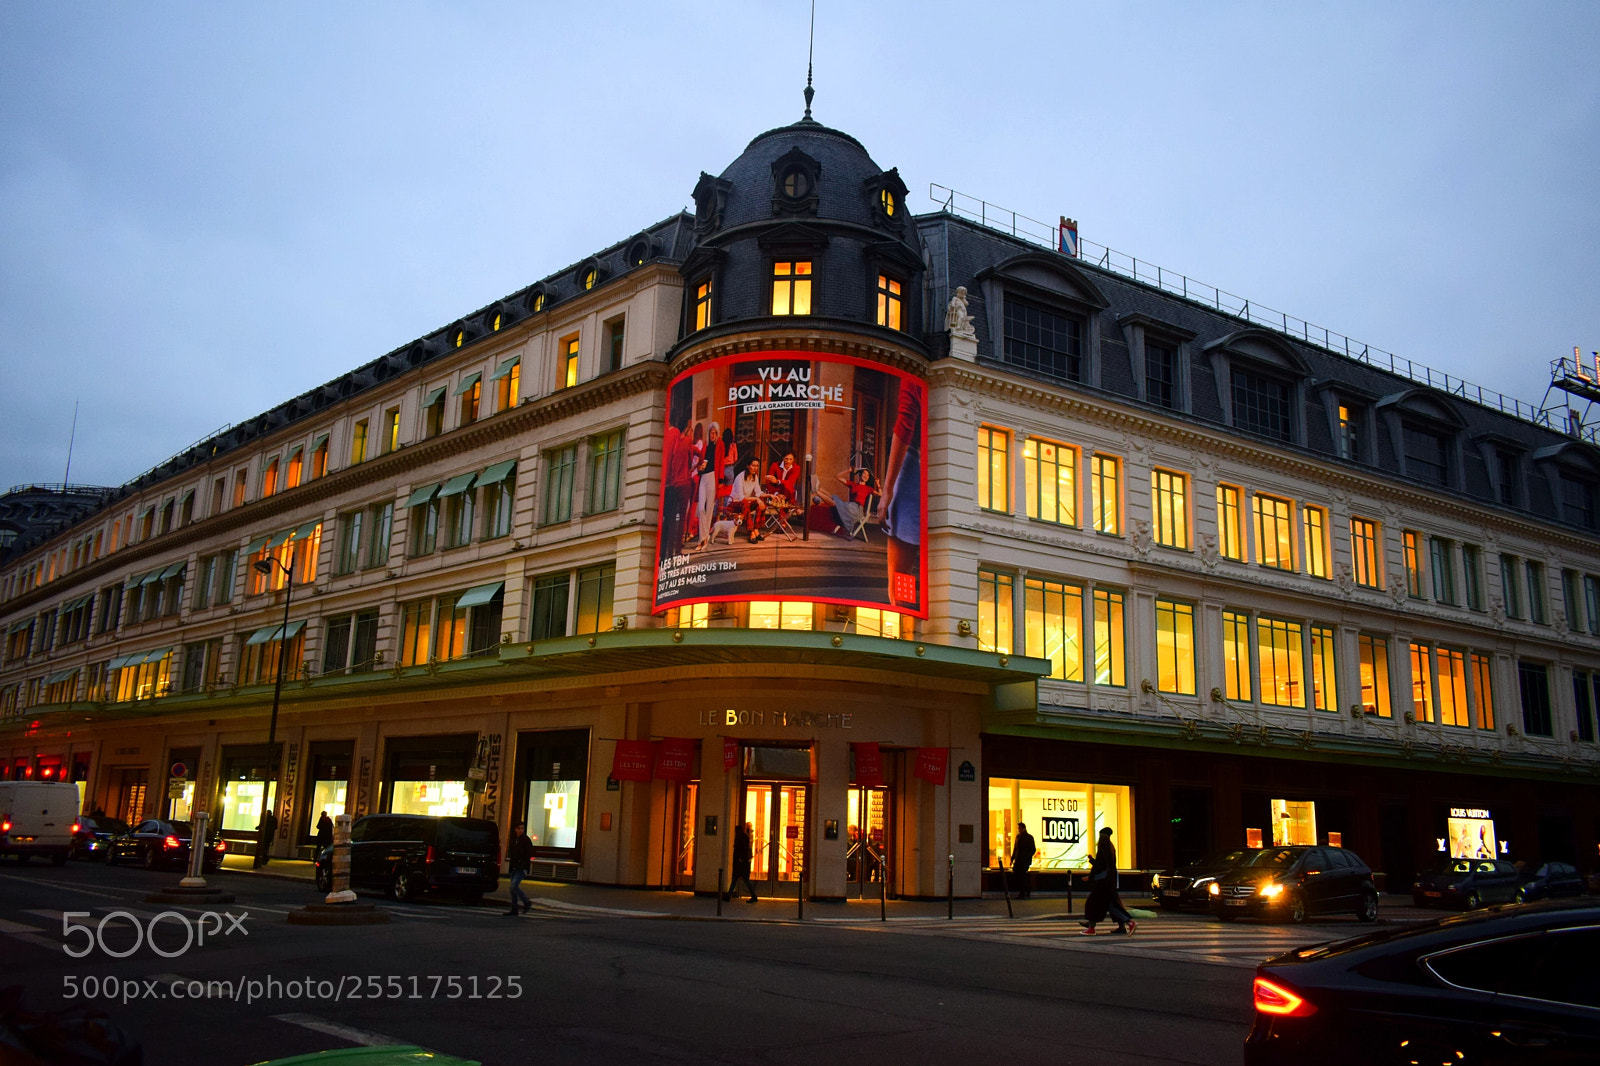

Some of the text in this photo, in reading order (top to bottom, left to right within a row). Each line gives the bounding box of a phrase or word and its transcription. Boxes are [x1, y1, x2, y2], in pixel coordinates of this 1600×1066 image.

[758, 367, 811, 382] VU AU
[728, 383, 843, 402] BON MARCHÉ
[795, 400, 821, 408] ÉPICERIE
[660, 554, 690, 571] LES TBM
[659, 571, 667, 582] LES
[680, 562, 717, 576] ATTENDUS
[718, 561, 737, 571] TBM
[658, 582, 665, 592] DU
[669, 579, 677, 588] AU
[686, 574, 706, 585] MARS
[699, 710, 719, 726] LE
[725, 709, 764, 726] BON
[1042, 798, 1078, 812] LET'S GO
[1450, 807, 1490, 819] LOUIS VUITTON
[1042, 819, 1079, 841] LOGO!
